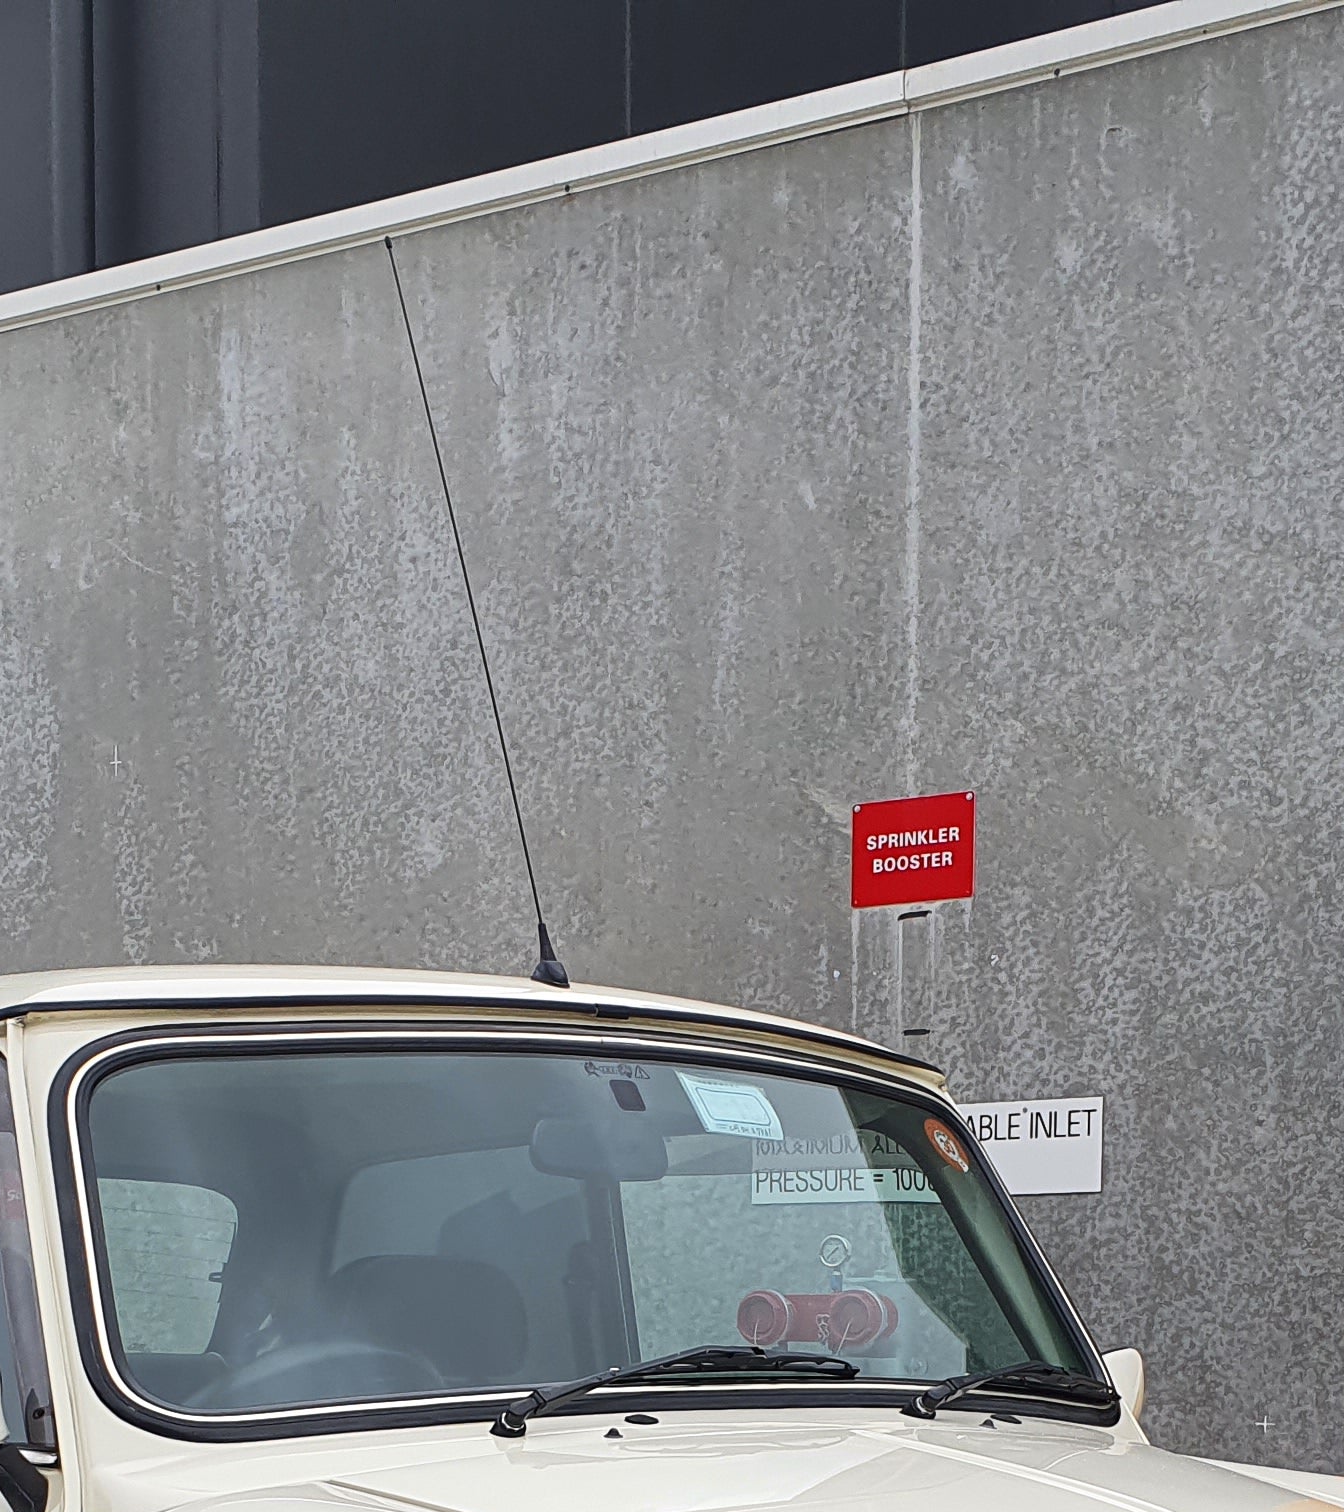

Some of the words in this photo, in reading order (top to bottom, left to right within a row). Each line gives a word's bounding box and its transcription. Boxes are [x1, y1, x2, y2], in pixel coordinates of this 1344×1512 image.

[866, 826, 960, 851] SPRINKLER
[872, 851, 953, 874] BOOSTER
[1030, 1108, 1097, 1139] INLET
[755, 1168, 864, 1193] PRESSURE
